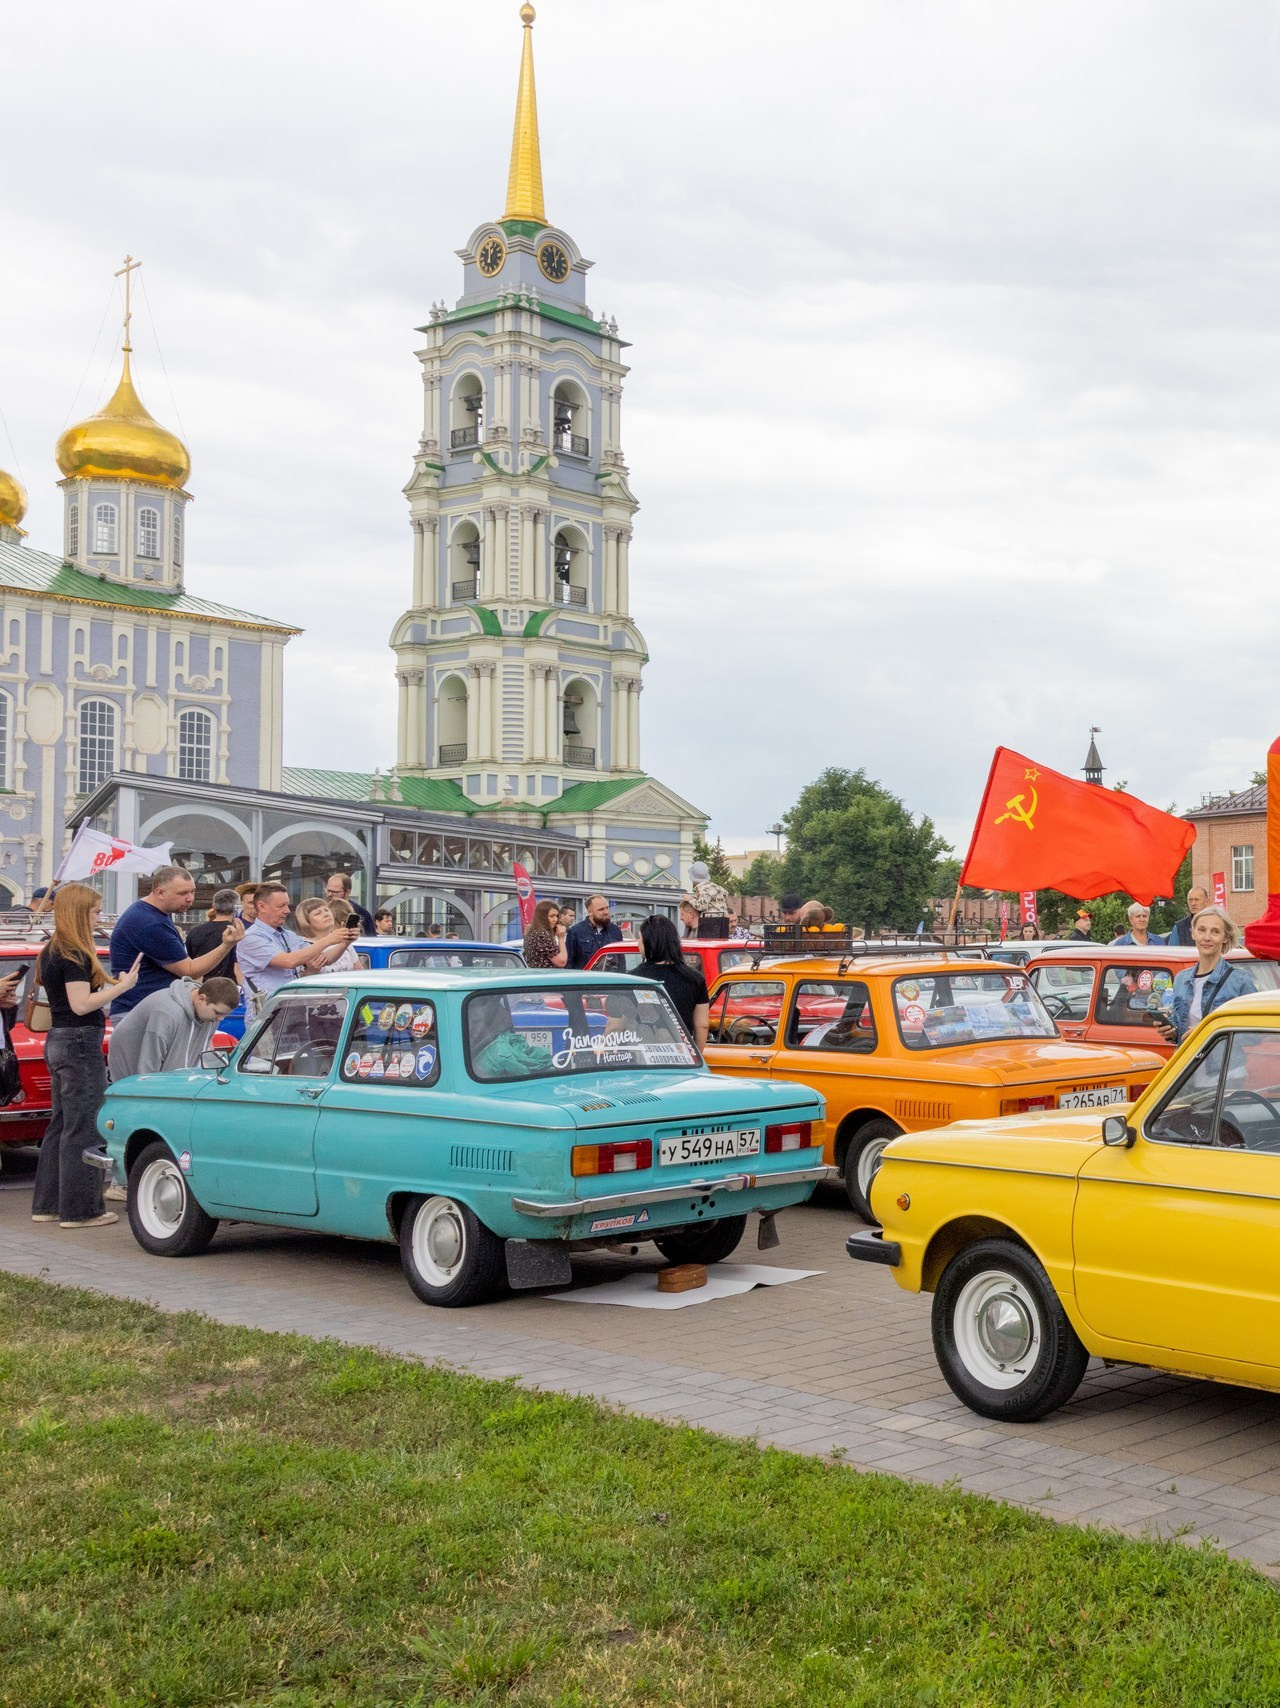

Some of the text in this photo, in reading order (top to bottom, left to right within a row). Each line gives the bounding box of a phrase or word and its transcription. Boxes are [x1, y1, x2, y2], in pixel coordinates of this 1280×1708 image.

[602, 1050, 633, 1063] Heritage
[1113, 1088, 1124, 1102] 71
[739, 1131, 755, 1148] 57
[593, 1217, 634, 1230] ХРУПКОЕ
